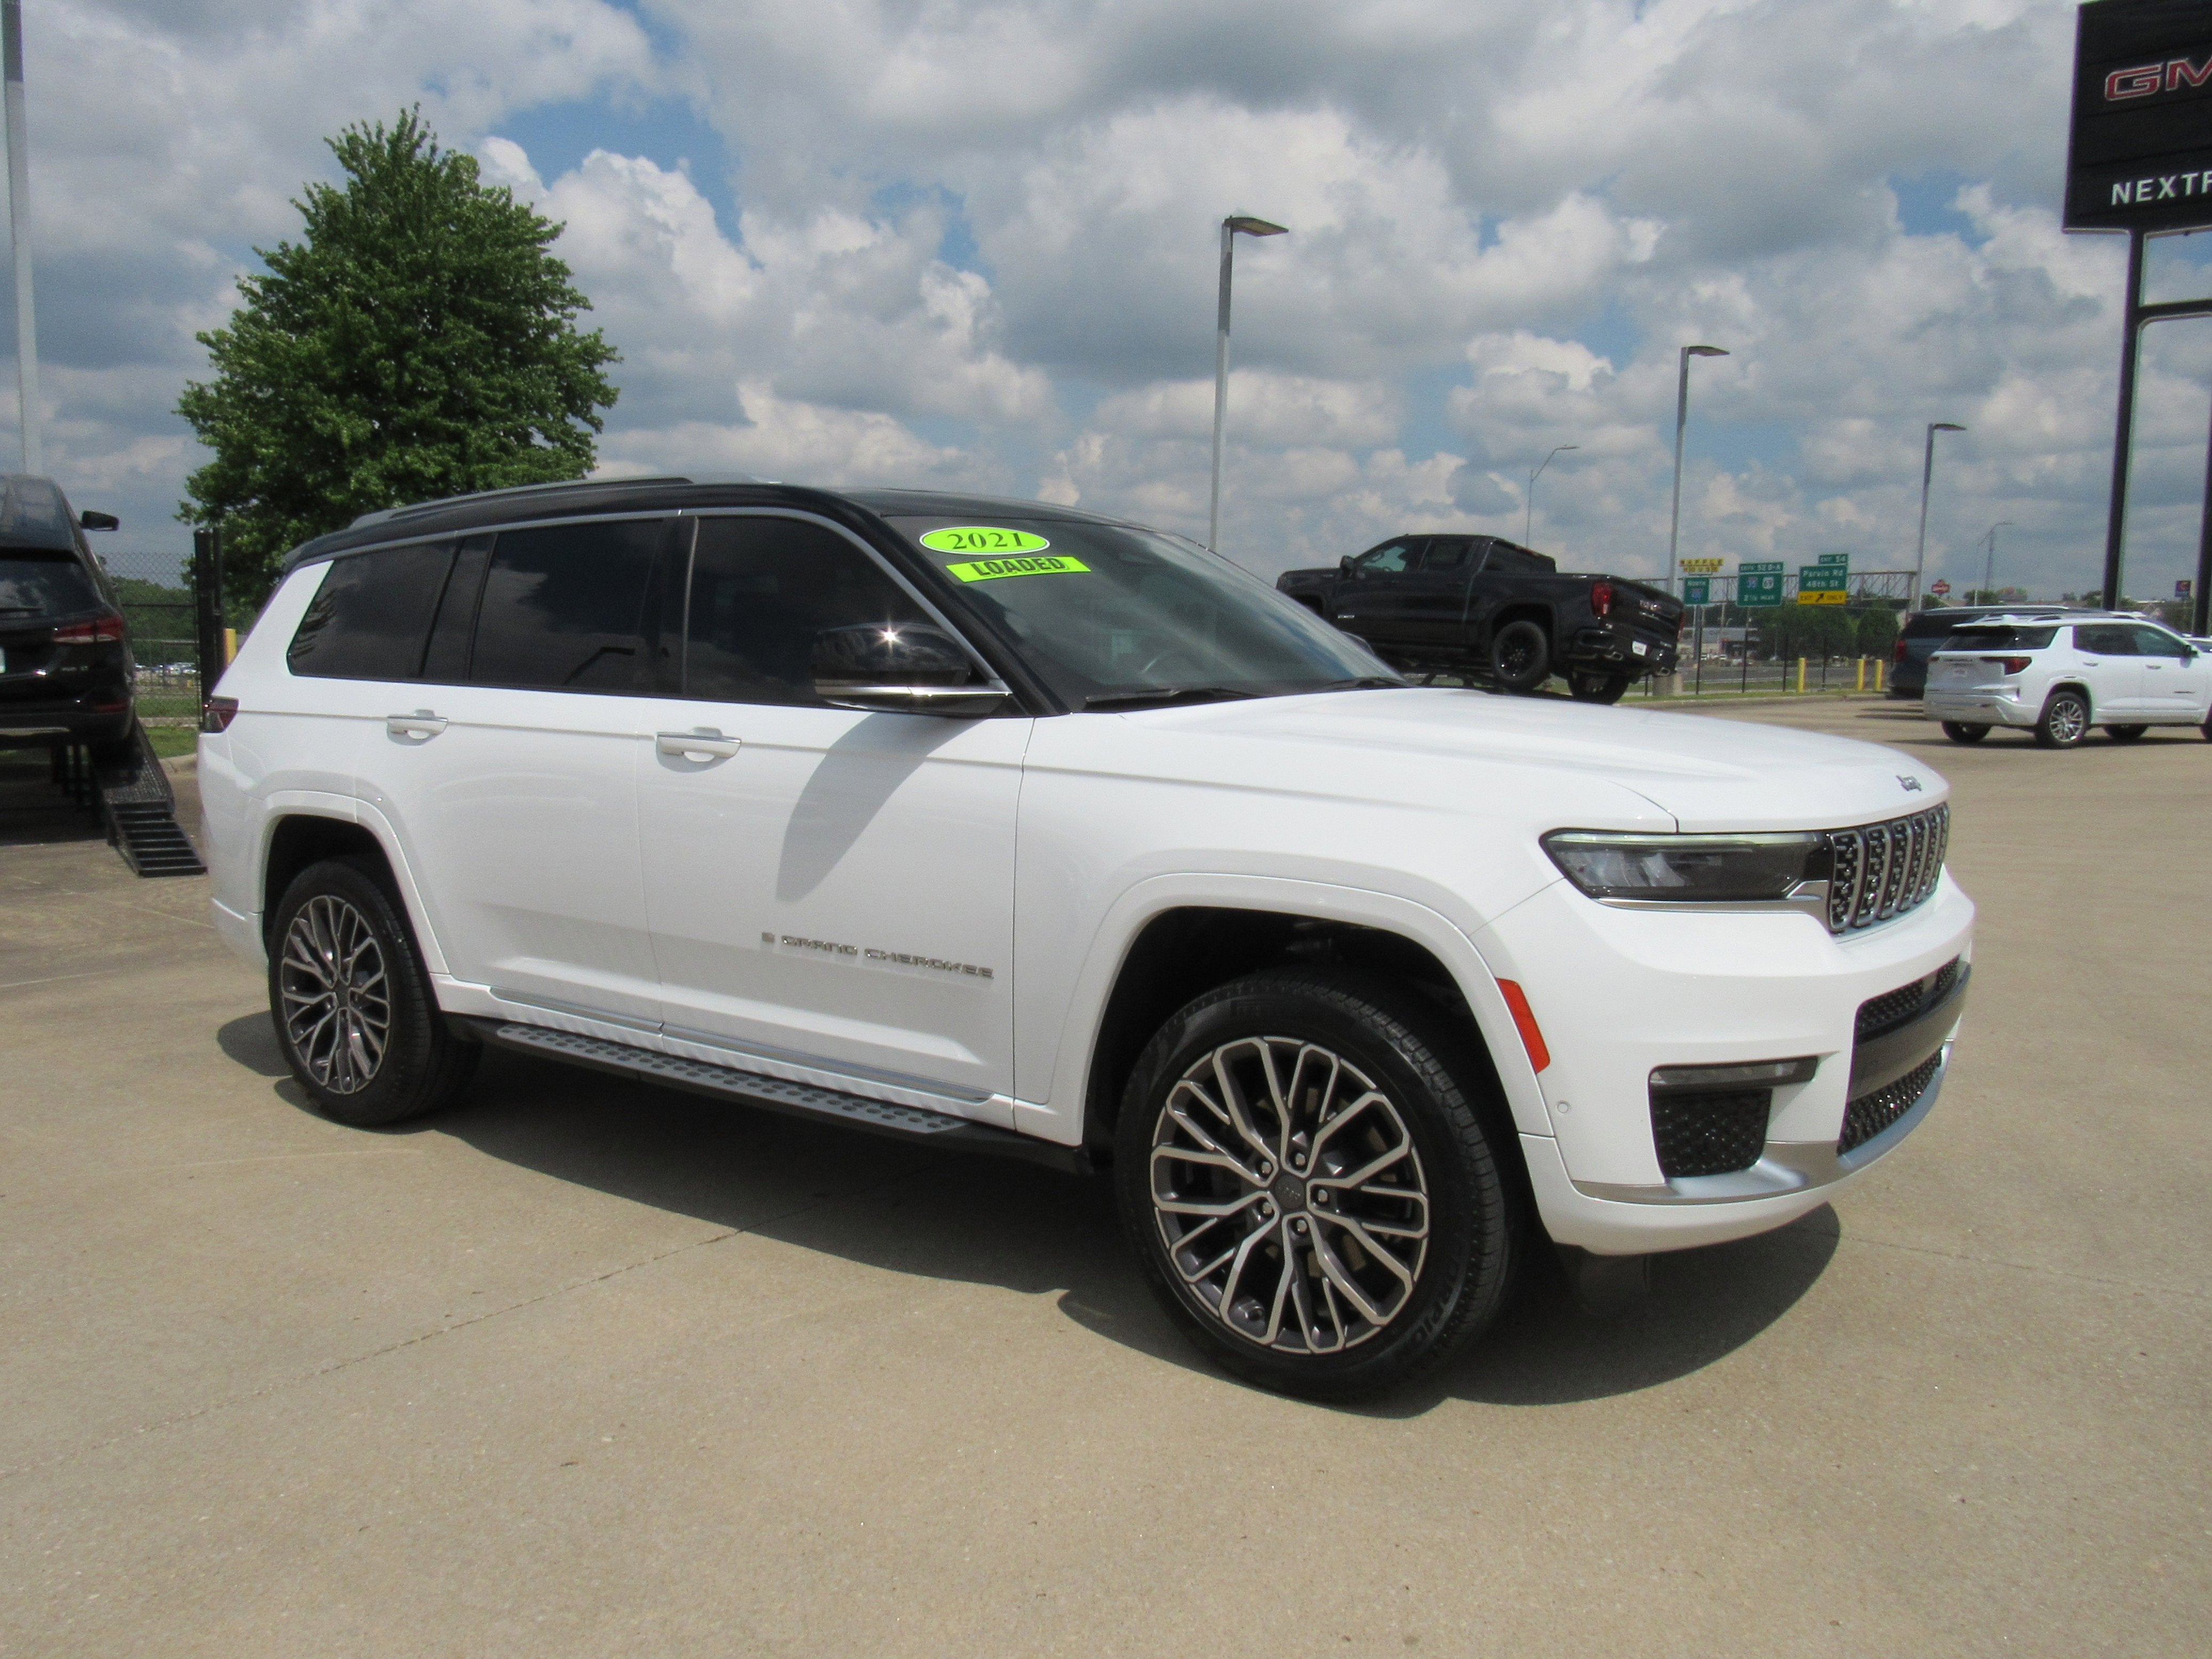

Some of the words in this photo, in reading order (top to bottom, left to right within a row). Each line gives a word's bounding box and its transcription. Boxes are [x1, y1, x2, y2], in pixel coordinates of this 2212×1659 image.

[947, 532, 1026, 550] 2021
[971, 558, 1070, 576] LOADED
[781, 935, 858, 956] GRAND
[864, 948, 994, 979] CHEROKEE
